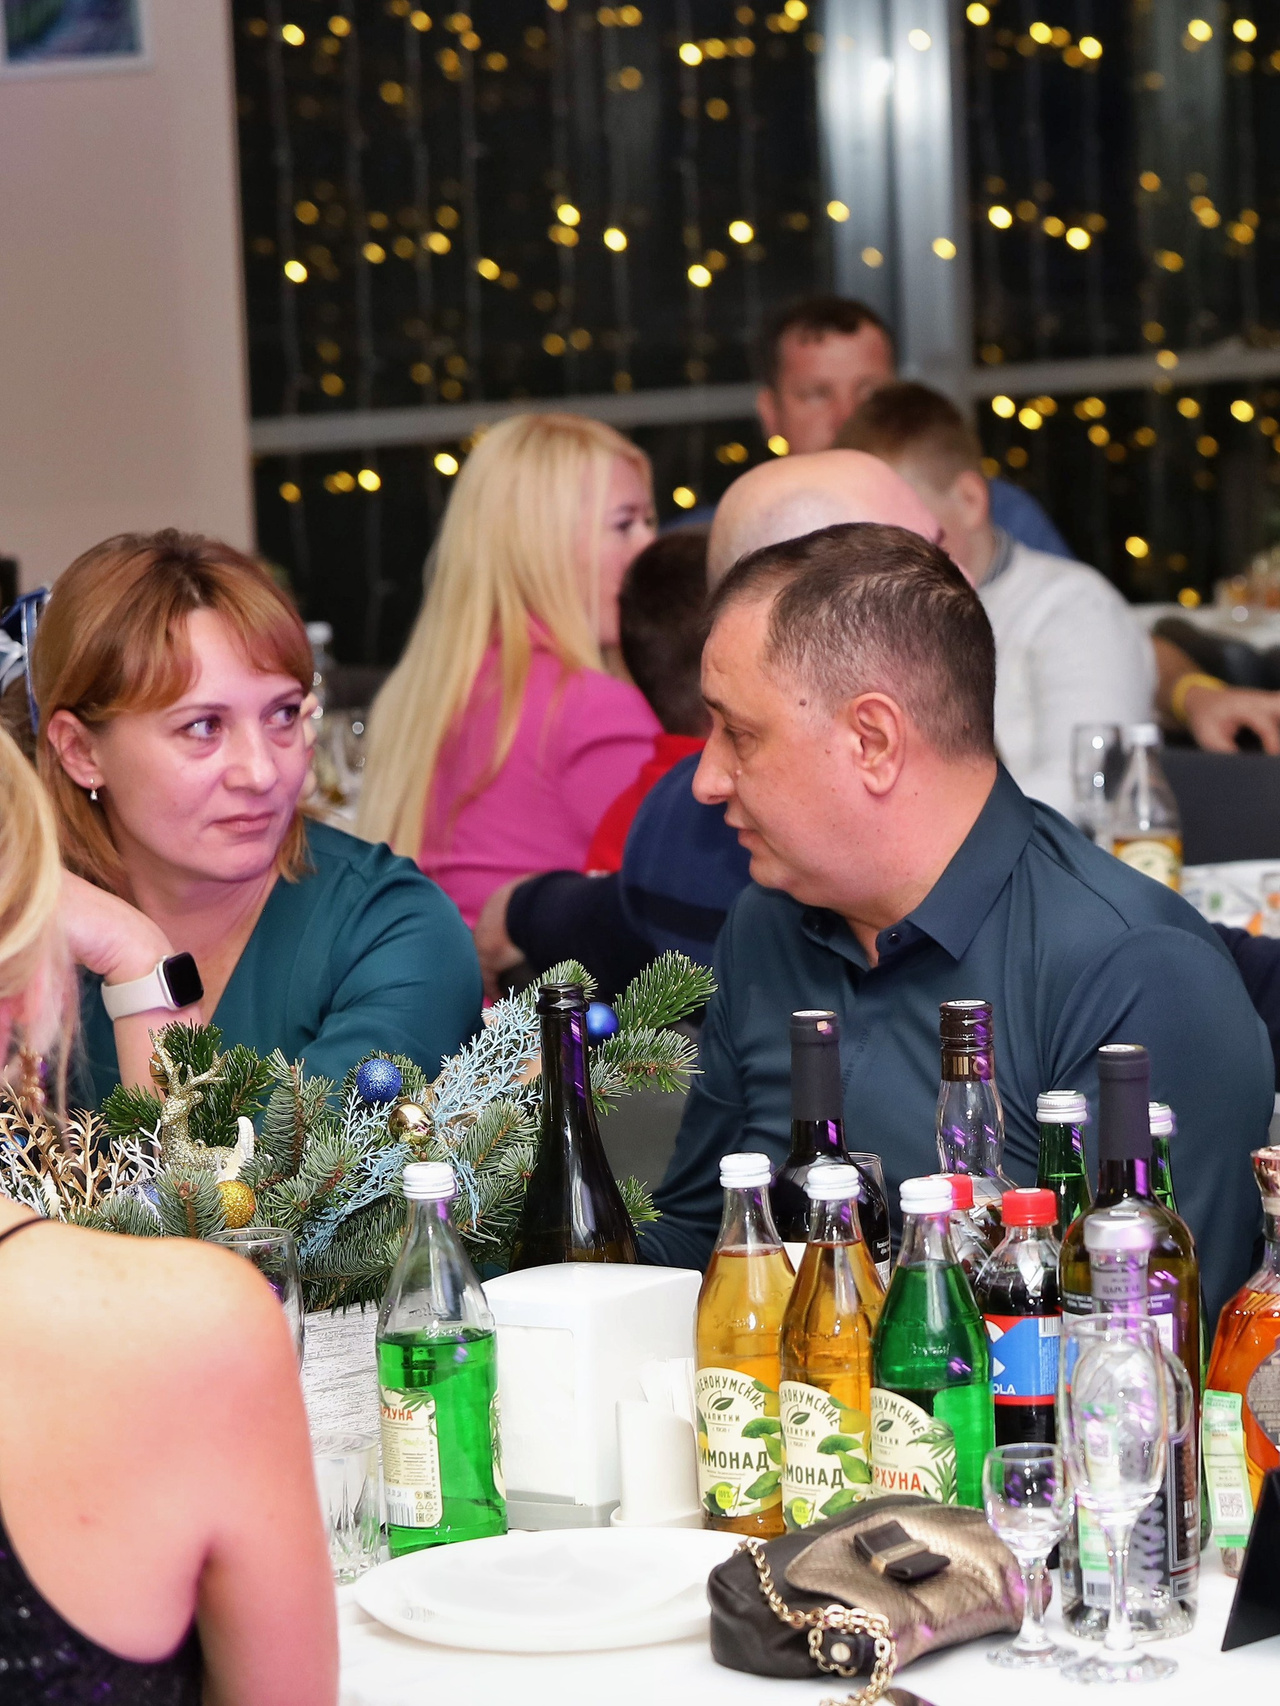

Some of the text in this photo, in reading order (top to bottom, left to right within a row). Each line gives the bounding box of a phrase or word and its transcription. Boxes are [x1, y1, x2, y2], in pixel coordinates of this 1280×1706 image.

[697, 1375, 767, 1410] ЕНОКУМСКИЕ
[699, 1447, 769, 1471] ИМОНАД
[783, 1462, 844, 1488] МОНАД
